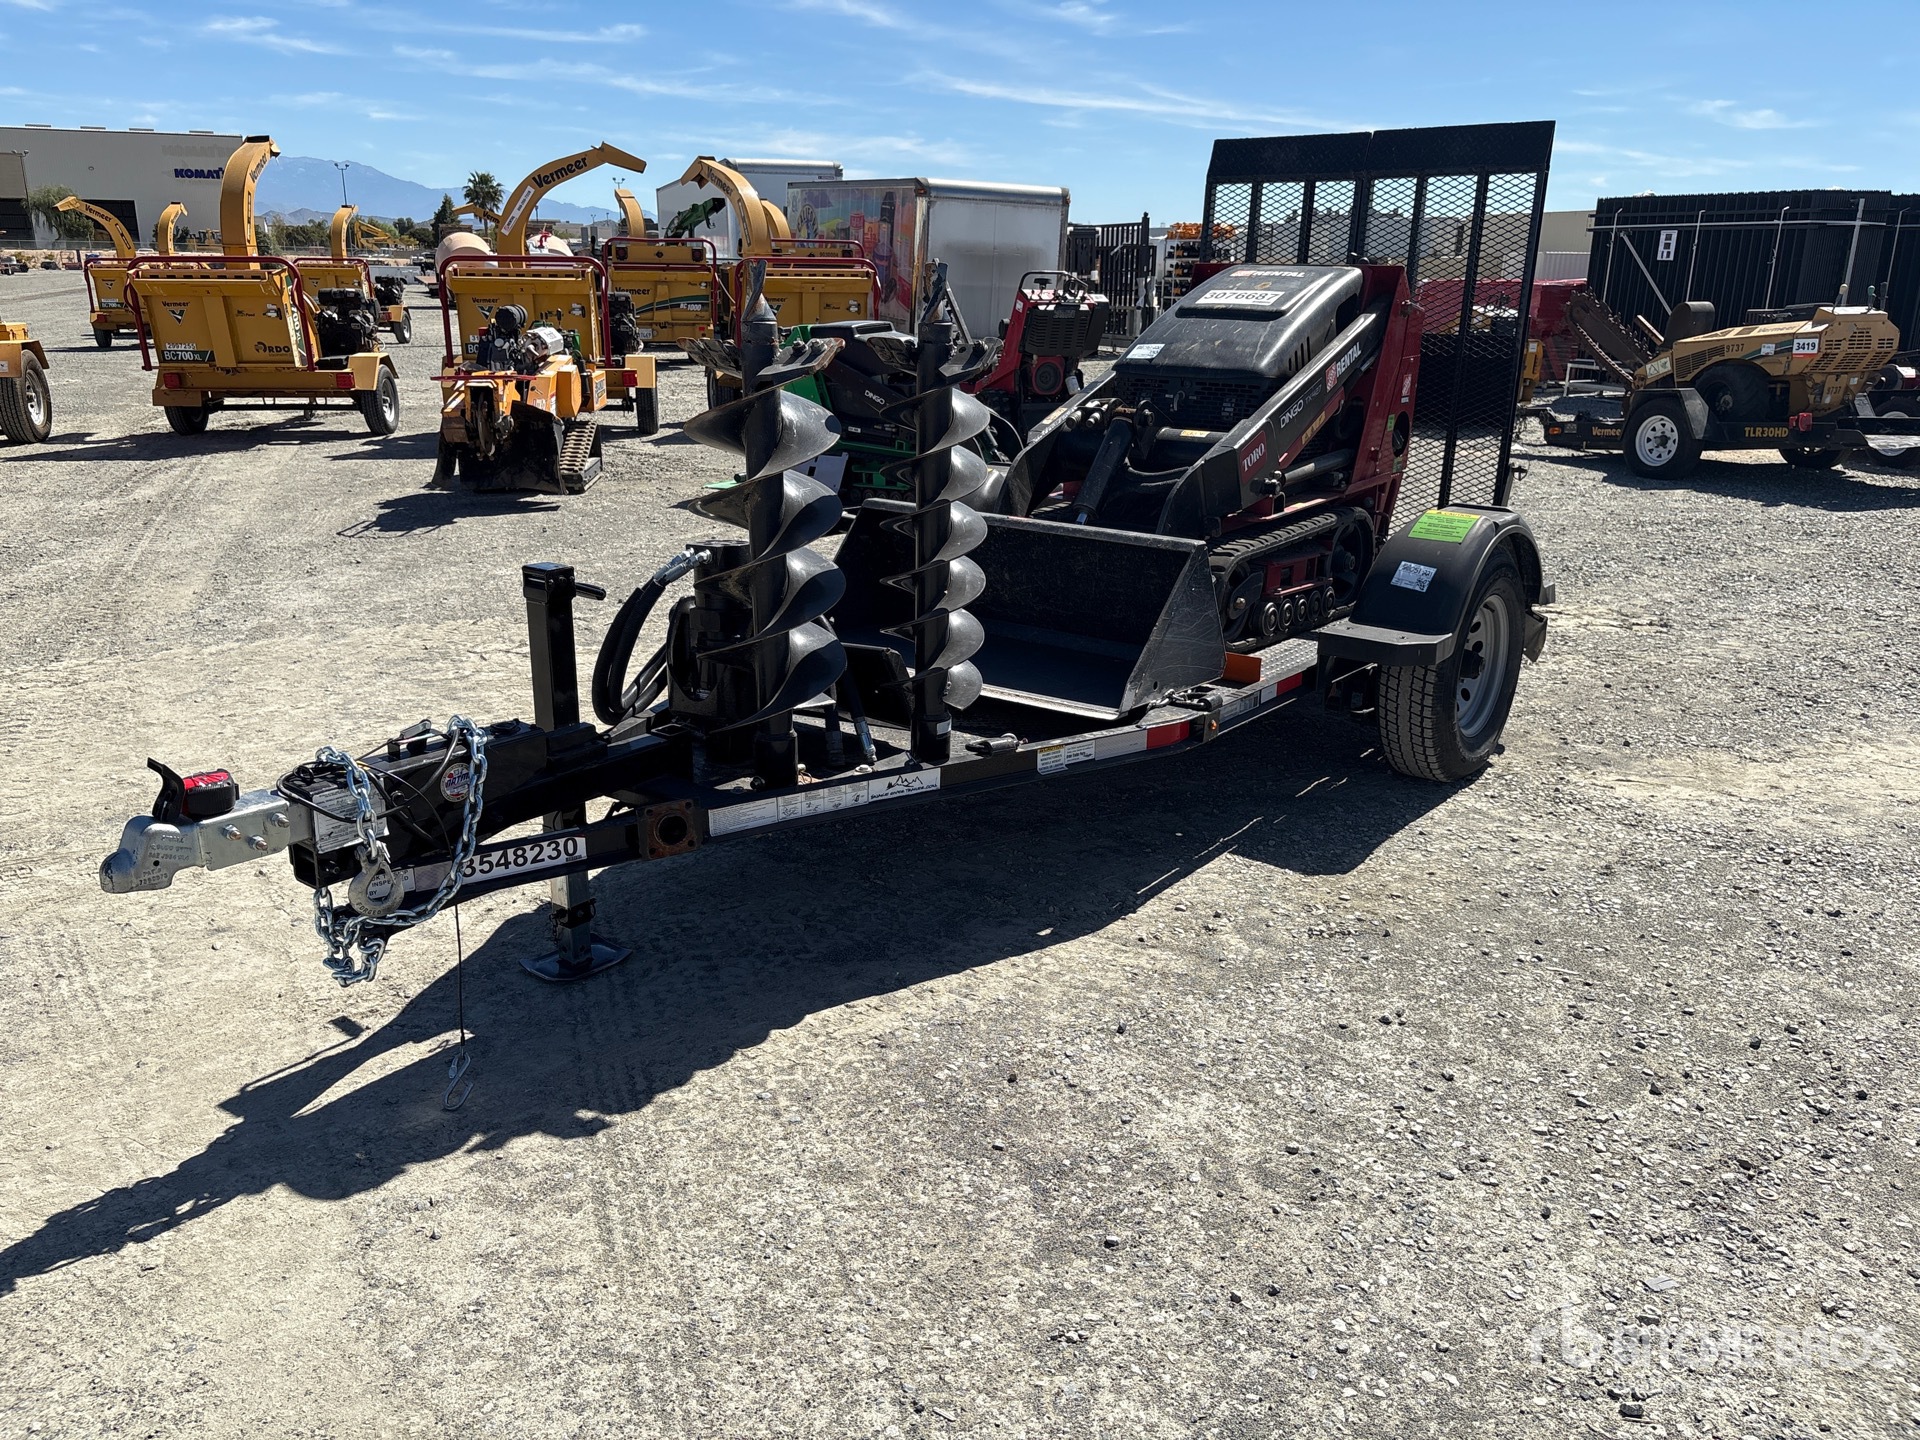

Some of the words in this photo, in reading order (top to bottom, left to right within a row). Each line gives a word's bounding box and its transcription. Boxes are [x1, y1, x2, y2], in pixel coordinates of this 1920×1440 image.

[174, 168, 224, 179] KOMAT
[532, 157, 588, 189] Vermeer
[706, 166, 733, 197] Vermeer
[85, 204, 112, 222] Vermeer
[615, 287, 650, 295] Vermeer
[1204, 291, 1280, 301] 3076687
[1725, 344, 1745, 353] 9737
[1795, 341, 1816, 351] 3419
[1337, 342, 1361, 378] RENTAL
[864, 390, 886, 405] DINGO
[1280, 400, 1304, 429] DINGO
[1592, 426, 1621, 436] Vermee
[1744, 427, 1789, 438] TLR30HD
[1242, 443, 1265, 472] TORO
[462, 837, 578, 878] 3548230
[356, 902, 382, 915] FORGED
